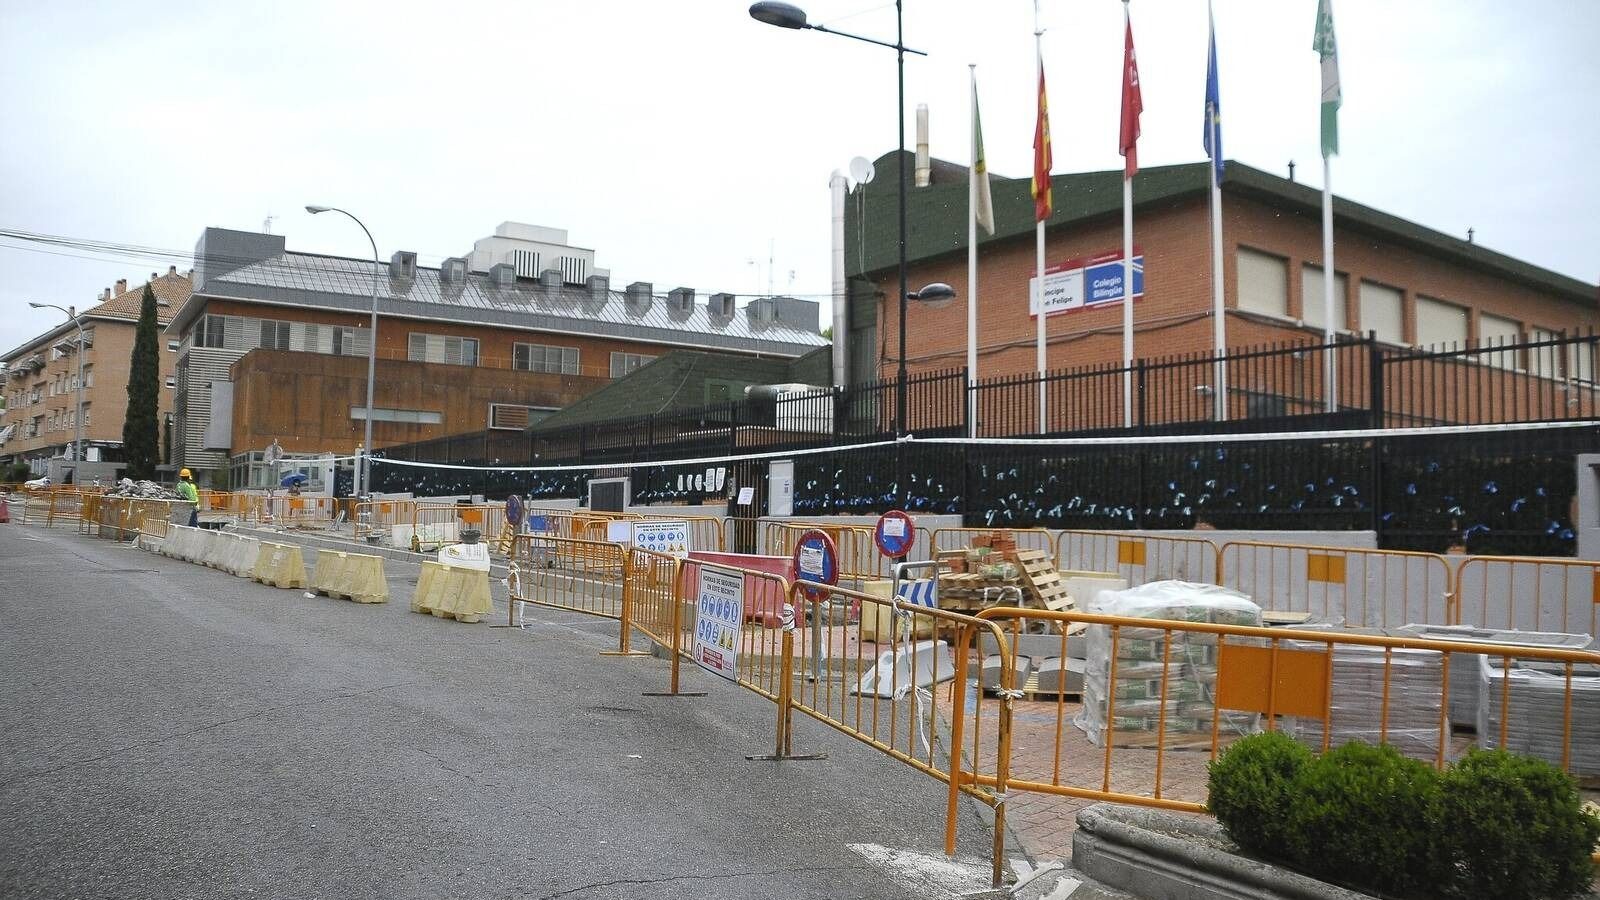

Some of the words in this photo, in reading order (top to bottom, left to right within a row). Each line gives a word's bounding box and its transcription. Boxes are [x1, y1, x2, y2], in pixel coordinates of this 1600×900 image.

[1093, 277, 1121, 288] Colegio
[1093, 286, 1122, 298] Bilingüe
[1052, 297, 1073, 305] Felipe
